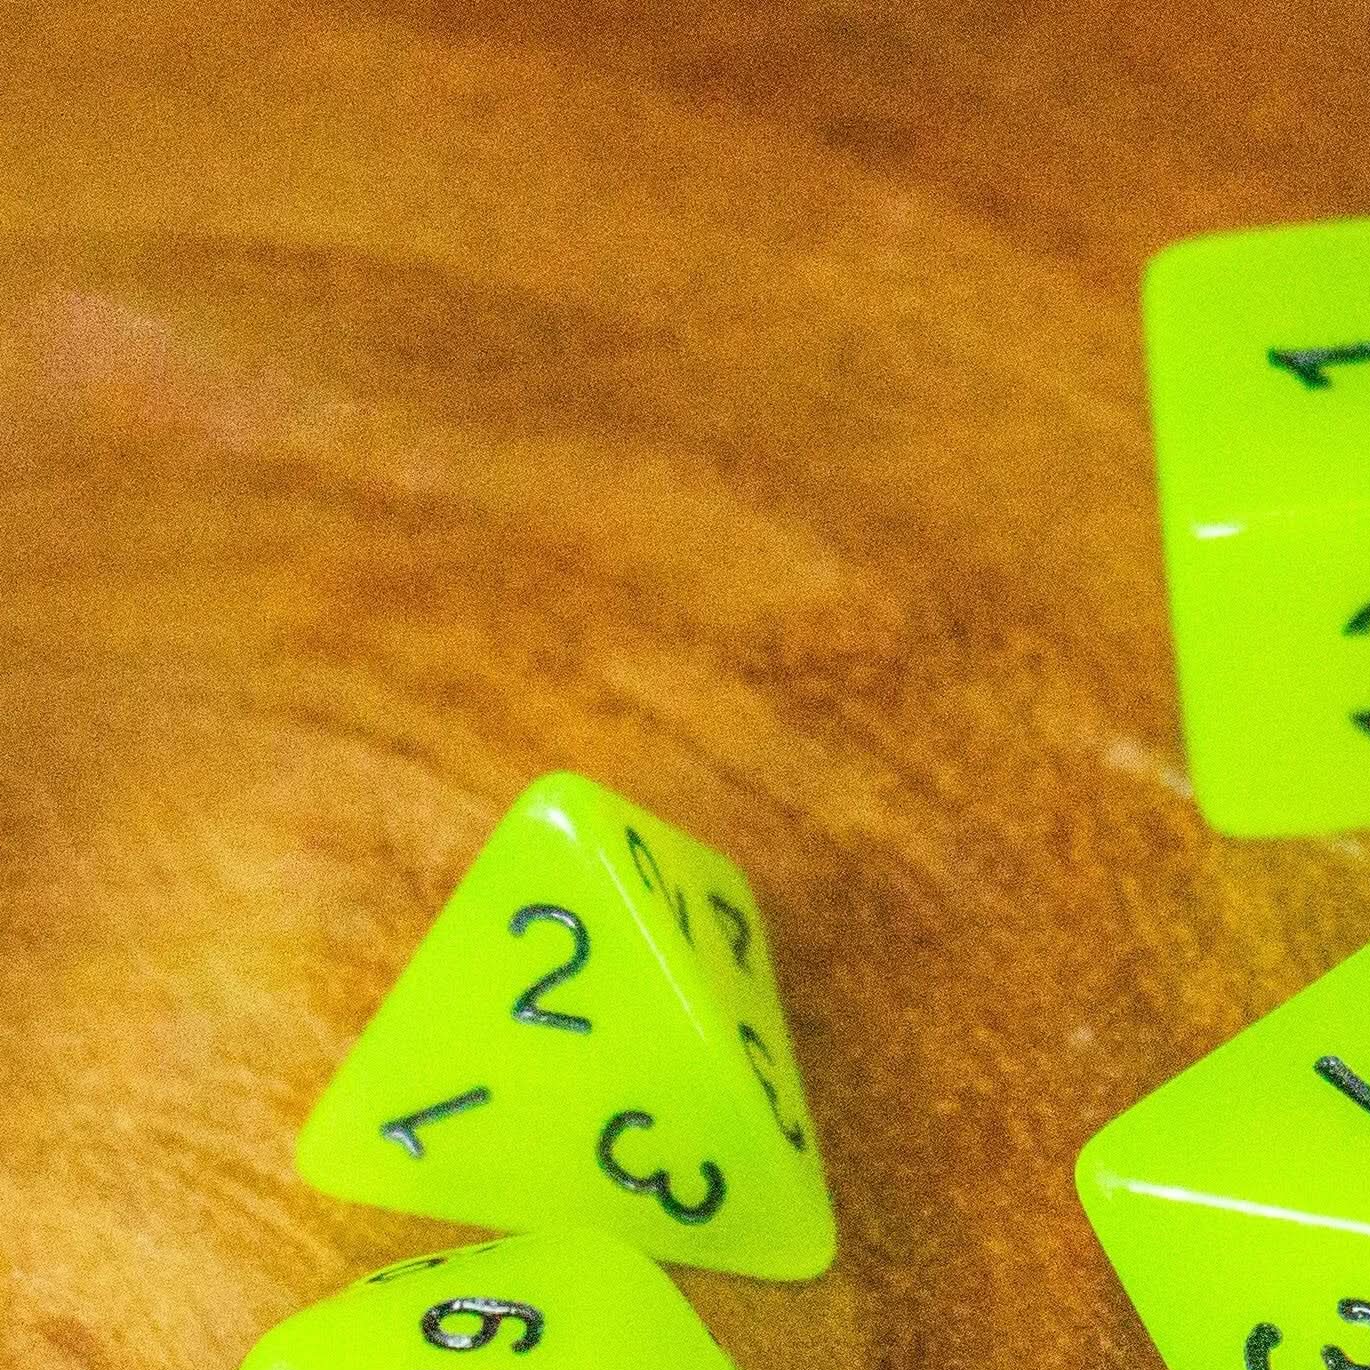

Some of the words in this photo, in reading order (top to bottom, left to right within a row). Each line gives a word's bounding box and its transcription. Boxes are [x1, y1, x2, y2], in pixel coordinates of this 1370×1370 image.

[508, 902, 594, 1034] 2
[379, 1086, 492, 1160] 1
[595, 1109, 728, 1227] 3
